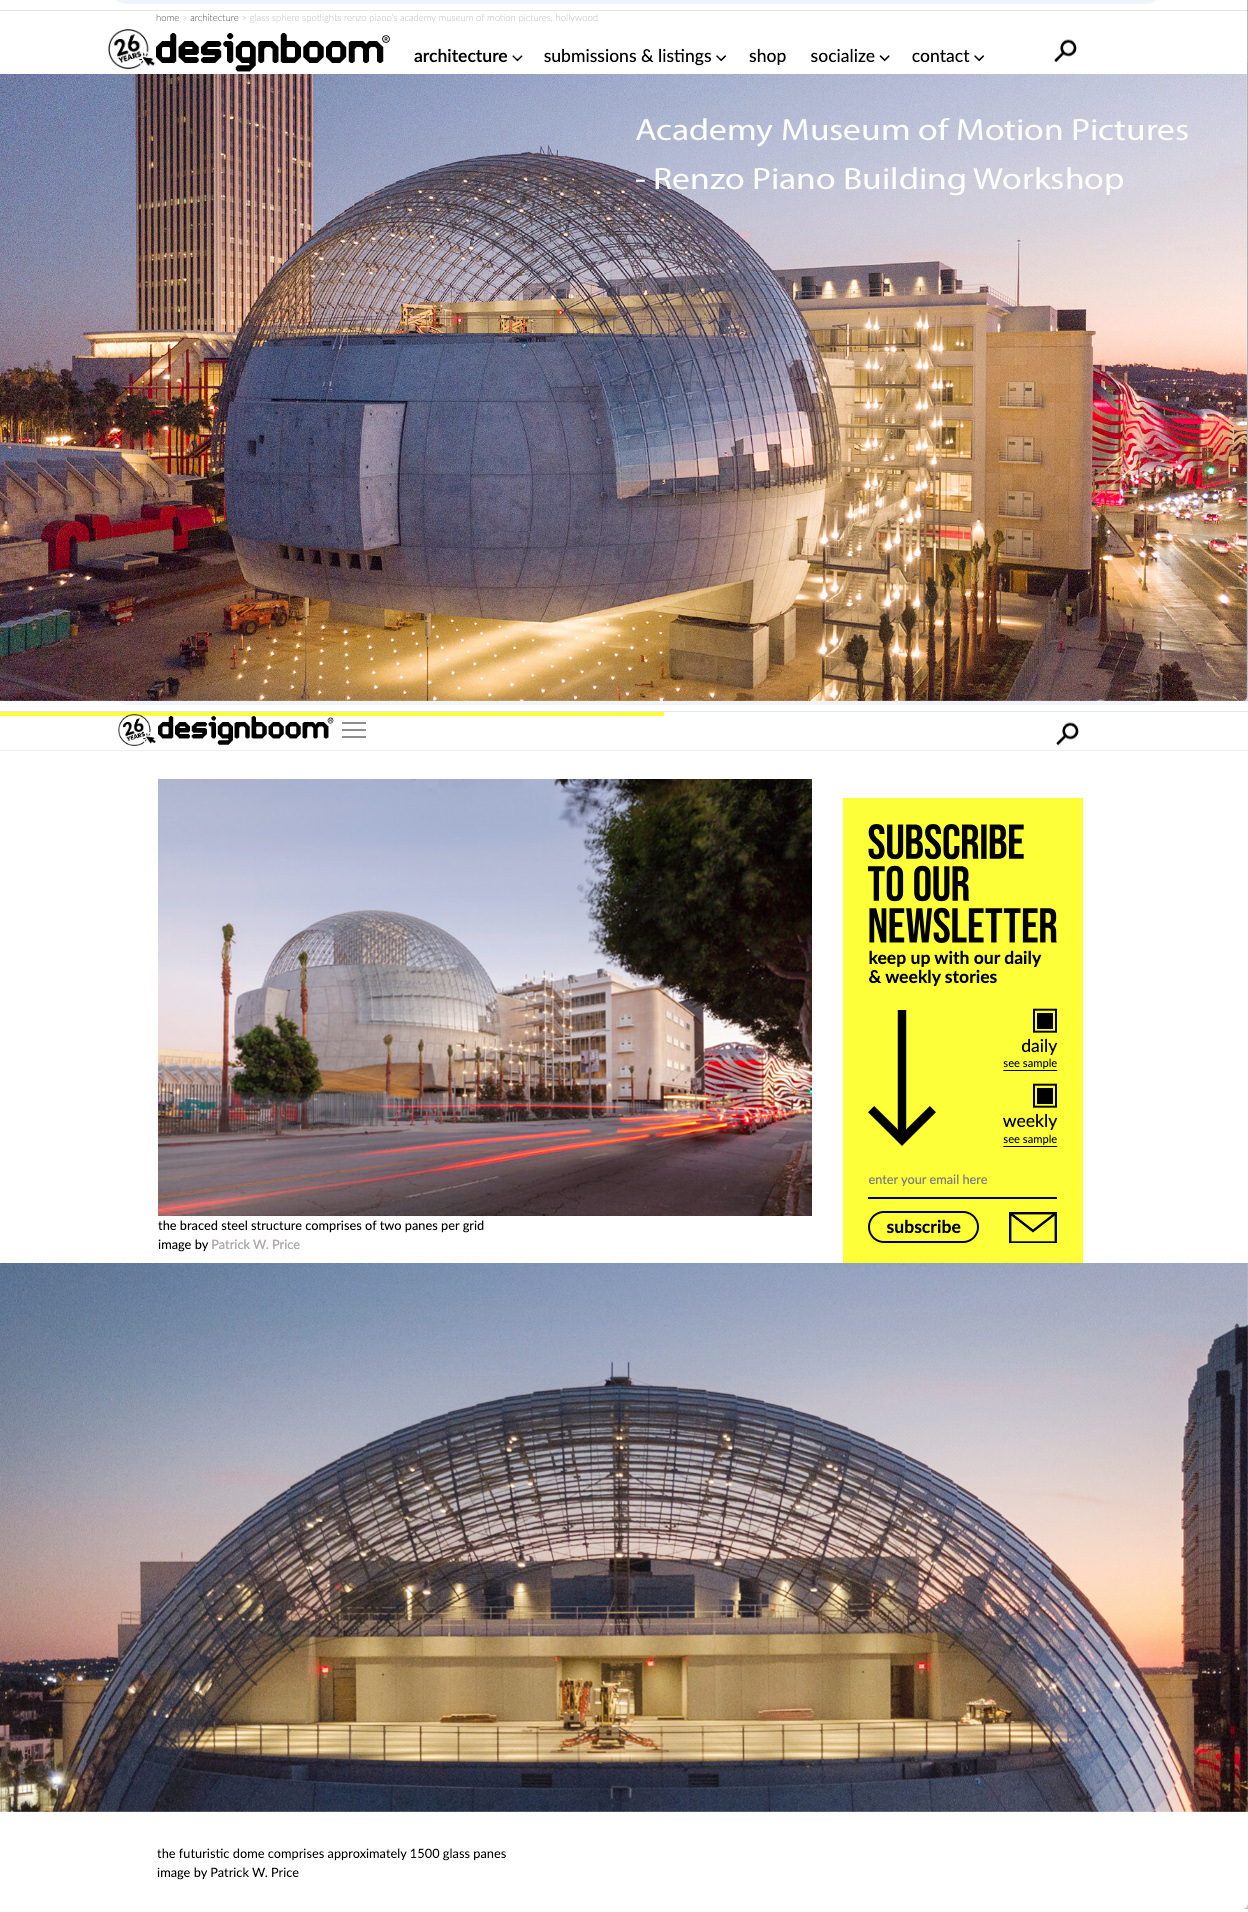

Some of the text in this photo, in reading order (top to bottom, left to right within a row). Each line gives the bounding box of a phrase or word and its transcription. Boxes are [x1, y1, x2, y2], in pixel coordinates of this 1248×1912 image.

[155, 13, 179, 22] home
[189, 13, 239, 22] architecture
[249, 13, 269, 23] glass
[271, 13, 299, 23] sphere
[301, 13, 341, 23] spotlights
[369, 13, 397, 23] piano's
[399, 13, 436, 23] academy
[475, 13, 484, 22] of
[486, 13, 515, 22] motion
[518, 13, 552, 23] pictures,
[555, 13, 598, 23] hollywood
[114, 34, 140, 56] 26
[117, 50, 142, 63] YEARS
[414, 49, 507, 62] architecture
[544, 49, 711, 65] submissions & listings
[750, 49, 786, 65] shop
[811, 49, 875, 62] socialize
[911, 49, 969, 62] contact
[123, 718, 144, 736] 26
[868, 824, 1024, 859] SUBSCRIBE
[868, 866, 969, 901] TO OUR
[869, 908, 1057, 943] NEWSLETTER
[869, 951, 1041, 967] keep up with our daily
[869, 970, 997, 986] & weekly stories
[1022, 1039, 1057, 1055] daily
[1003, 1058, 1057, 1069] see sample
[1003, 1114, 1057, 1130] weekly
[1003, 1134, 1057, 1145] see sample
[868, 1173, 987, 1186] enter your email here
[157, 1219, 484, 1233] the braced steel structure comprises of two panes per grid
[887, 1220, 960, 1233] subscribe
[158, 1238, 300, 1252] image by Patrick W. Price
[156, 1847, 506, 1860] the futuristic dome comprises approximately 1500 glass panes
[157, 1866, 299, 1880] image by Patrick W. Price
